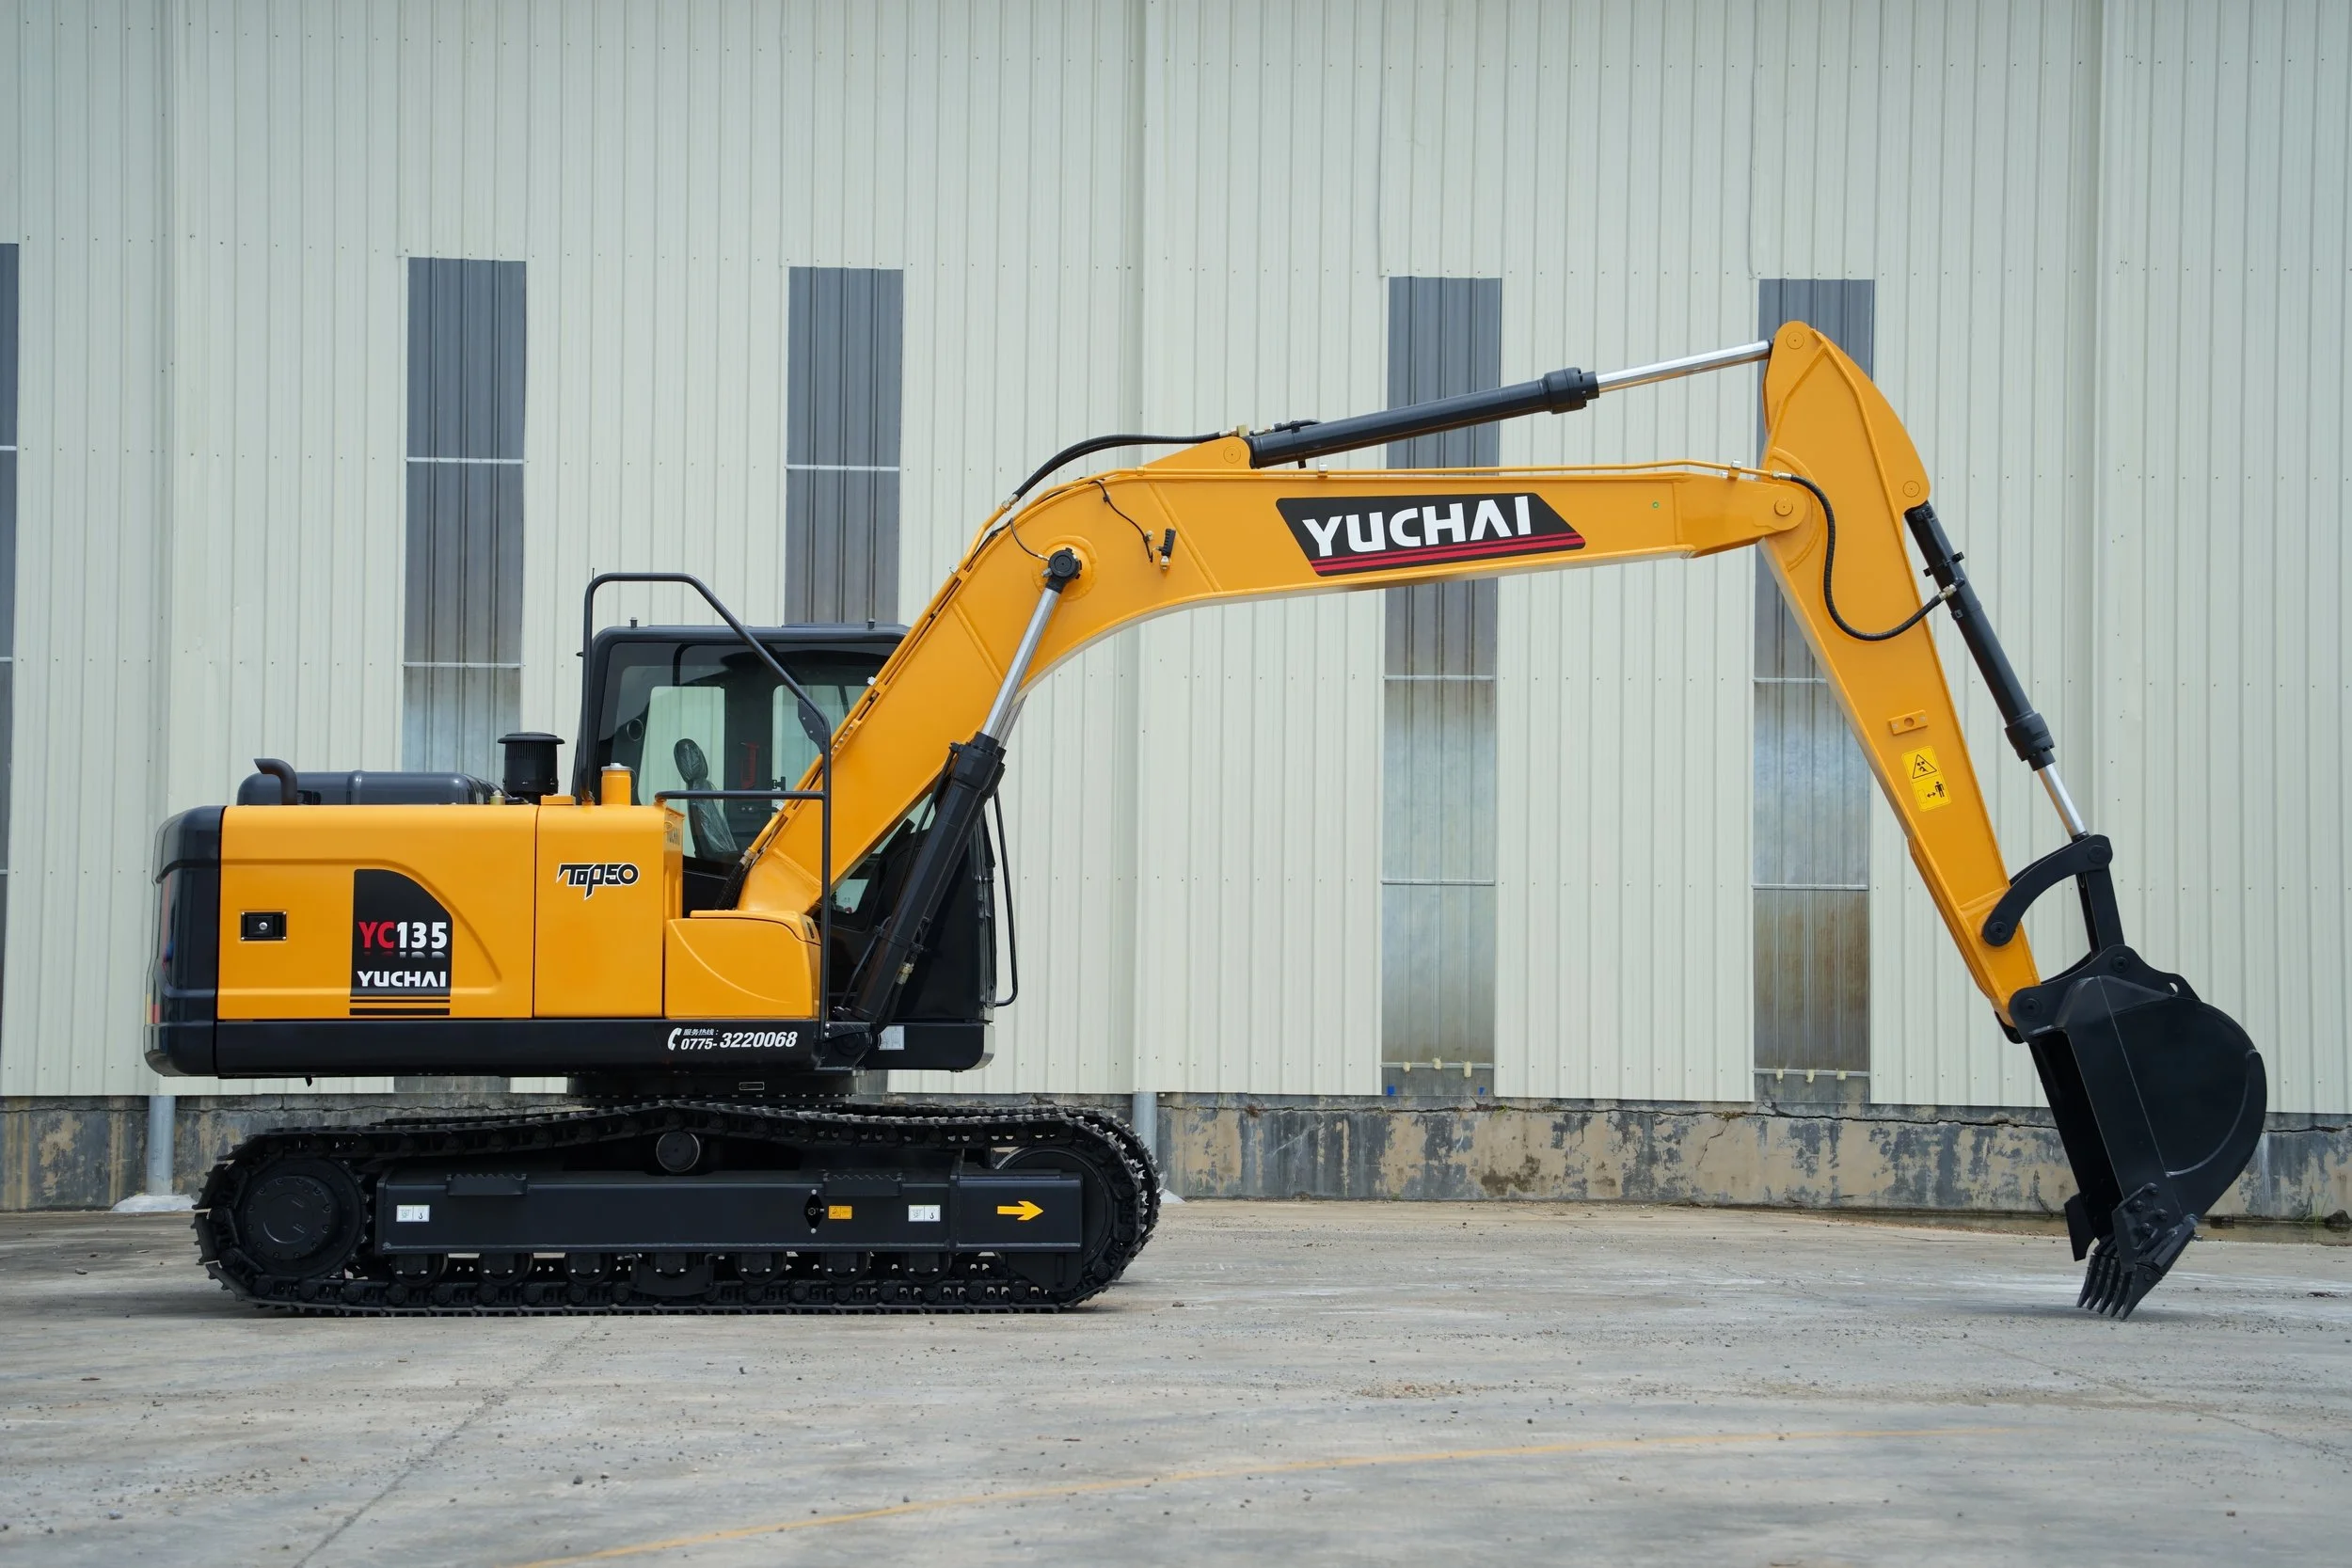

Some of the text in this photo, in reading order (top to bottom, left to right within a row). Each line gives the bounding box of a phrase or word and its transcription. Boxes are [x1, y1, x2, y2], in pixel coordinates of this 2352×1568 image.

[1302, 495, 1533, 557] YUCHAI
[358, 921, 448, 949] YC135
[357, 971, 447, 988] YUCHAI
